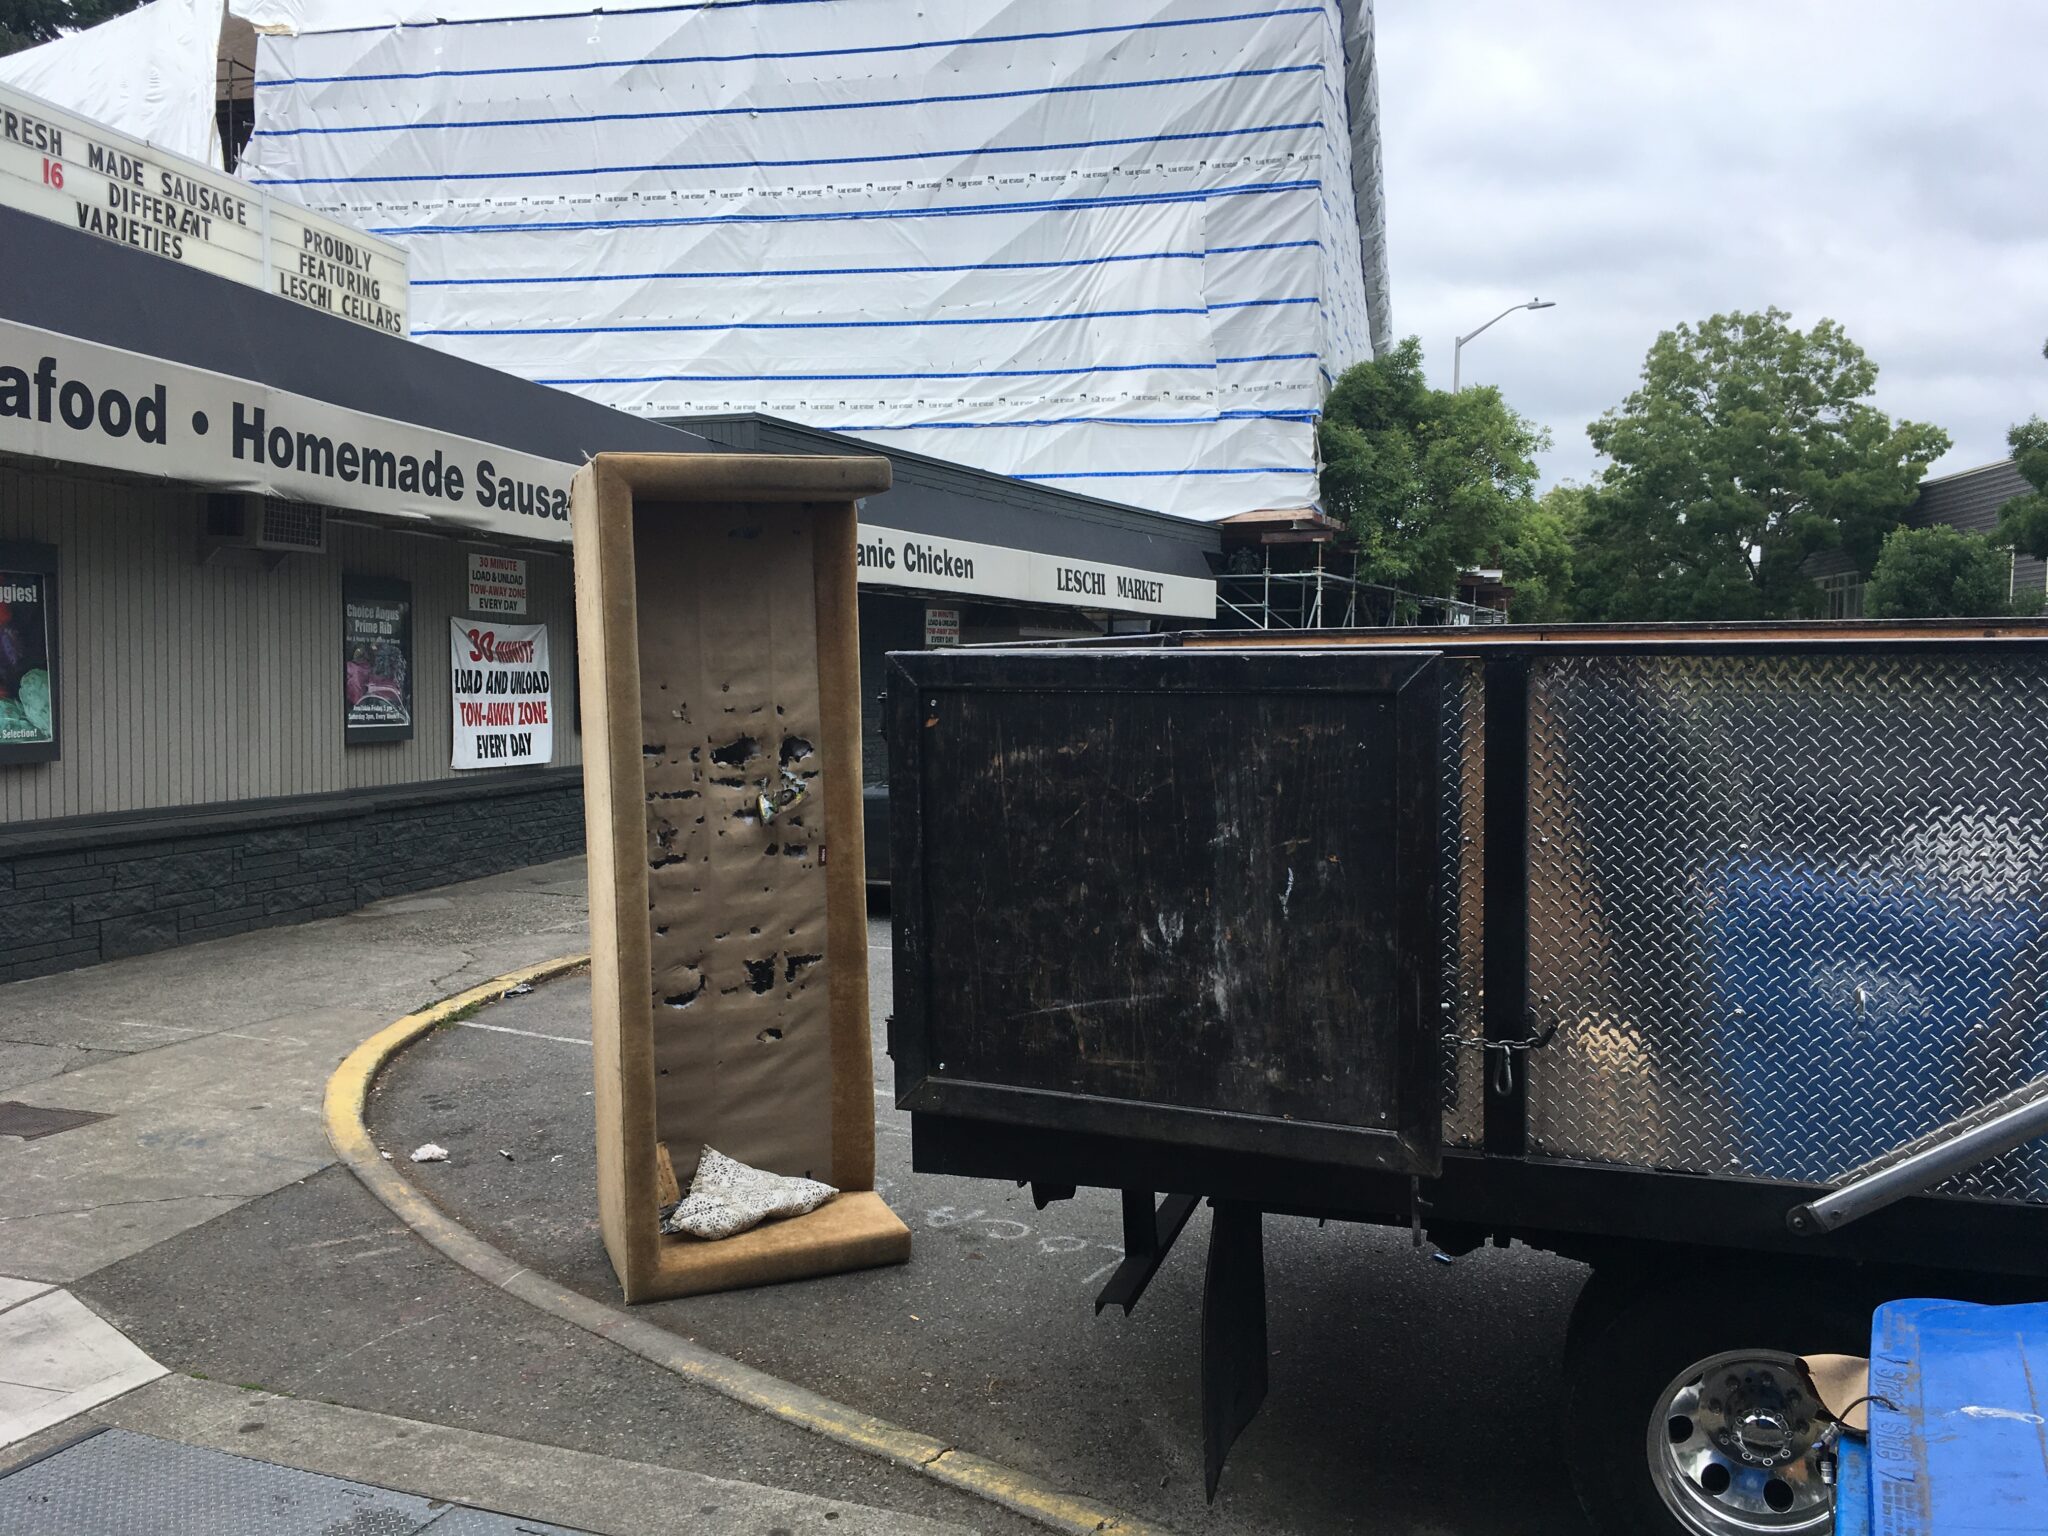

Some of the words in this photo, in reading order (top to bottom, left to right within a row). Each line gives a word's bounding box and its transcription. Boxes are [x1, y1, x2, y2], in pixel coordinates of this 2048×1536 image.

[0, 108, 62, 156] RESH
[88, 143, 144, 187] MADE
[162, 172, 246, 225] SAUSAGE
[43, 158, 64, 189] 16
[109, 184, 212, 241] DIFFERENT
[76, 202, 183, 259] VARIETIES
[303, 228, 372, 273] PROUDLY
[299, 253, 380, 301] FEATURING
[280, 272, 332, 310] LESCHI
[342, 295, 401, 332] CELLARS
[0, 357, 167, 445] afood
[233, 402, 464, 501] Homemade
[476, 459, 571, 524] Sausa
[479, 557, 488, 568] 30
[489, 557, 517, 571] MINUTE
[857, 538, 895, 569] anic
[903, 542, 974, 579] Chicken
[470, 583, 507, 596] TOW-AWAY
[509, 587, 526, 598] ZONE
[472, 570, 491, 582] LOAD
[491, 573, 497, 582] &
[498, 572, 523, 585] UNLOAD
[1056, 567, 1106, 596] LESCHI
[1117, 576, 1164, 603] MARKET
[346, 603, 374, 618] Choice
[479, 598, 503, 610] EVERY
[504, 599, 518, 611] DAY
[355, 619, 378, 633] Prime
[379, 622, 392, 634] Rib
[467, 629, 494, 663] 30
[495, 640, 534, 664] MINUTE
[454, 669, 482, 694] LOAD
[486, 670, 508, 694] AND
[510, 671, 549, 694] UNLOAD
[460, 702, 514, 727] TOW-AWAY
[518, 700, 548, 725] ZONE
[477, 733, 507, 758] EVERY
[510, 732, 532, 757] DAY
